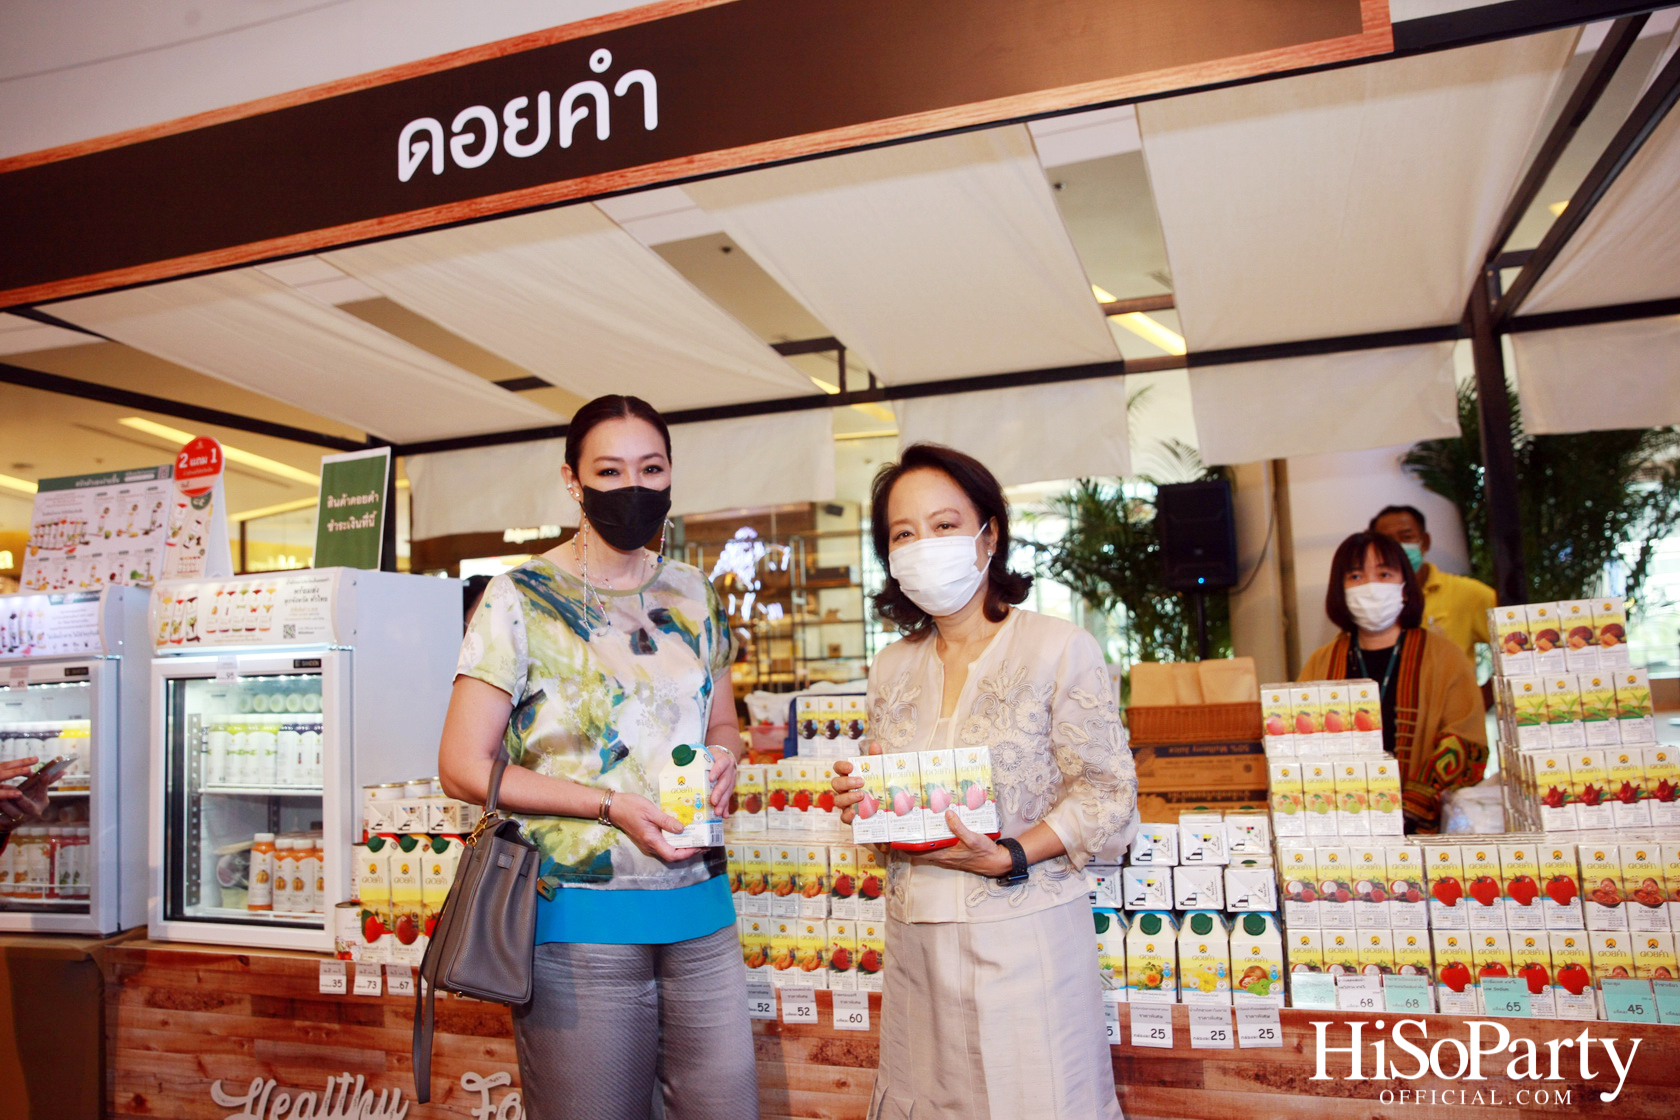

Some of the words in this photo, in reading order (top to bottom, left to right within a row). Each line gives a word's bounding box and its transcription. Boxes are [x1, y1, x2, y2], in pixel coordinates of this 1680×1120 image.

[398, 48, 658, 183] ดอยคำ
[178, 452, 189, 469] 2
[210, 447, 218, 464] 1
[332, 979, 343, 988] 35
[367, 980, 377, 990] 73
[399, 981, 410, 990] 67
[757, 1002, 770, 1012] 52
[1360, 998, 1374, 1008] 68
[1405, 998, 1420, 1009] 68
[1506, 1001, 1521, 1012] 65
[797, 1007, 811, 1017] 52
[1628, 1004, 1644, 1015] 45
[849, 1013, 863, 1023] 60
[1150, 1028, 1166, 1039] 25
[1210, 1030, 1226, 1041] 25
[1258, 1028, 1274, 1039] 25
[210, 1071, 409, 1120] Healthy
[460, 1071, 526, 1120] Fo
